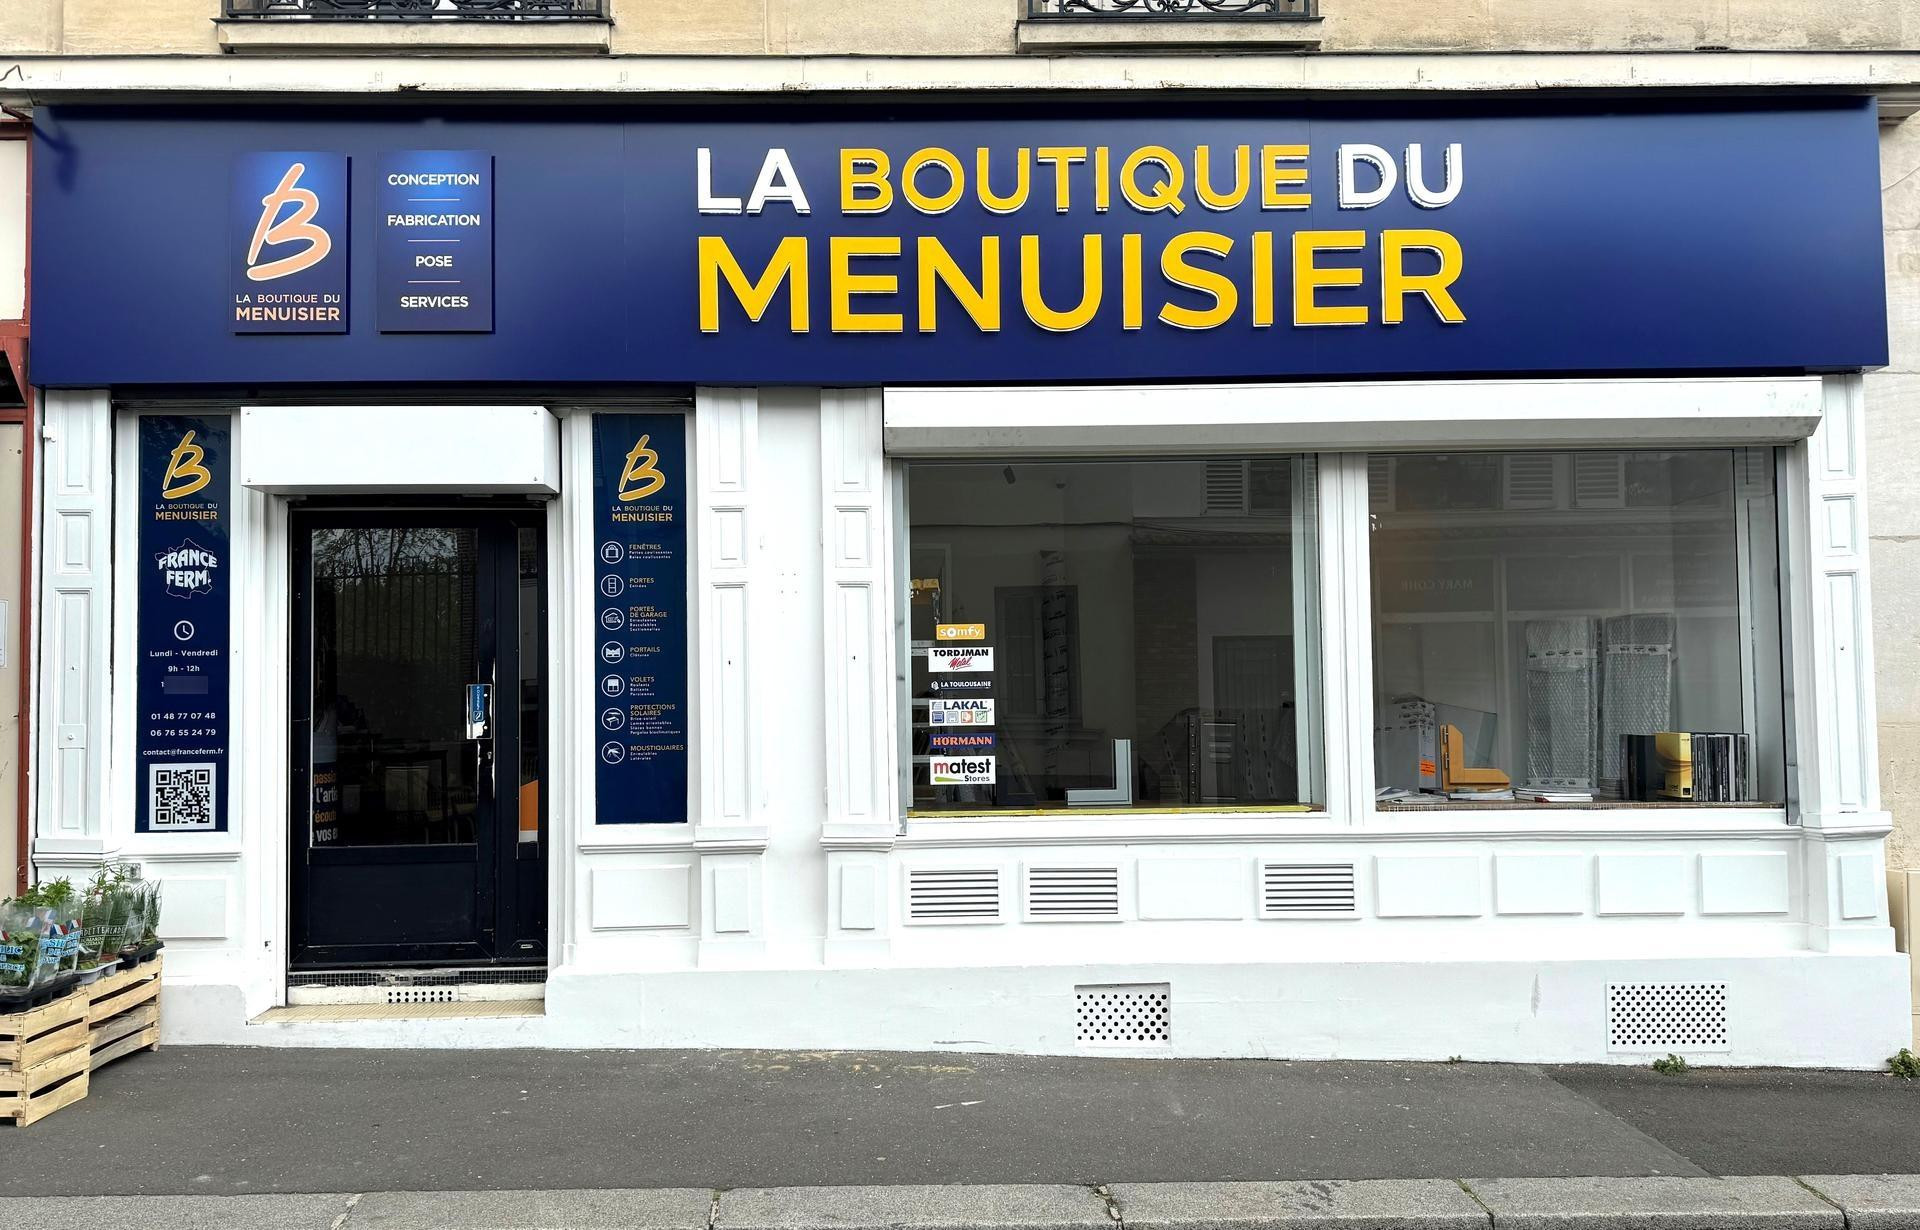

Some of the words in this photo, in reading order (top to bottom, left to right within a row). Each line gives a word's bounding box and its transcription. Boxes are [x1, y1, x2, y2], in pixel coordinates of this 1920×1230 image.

[387, 173, 480, 186] CONCEPTION
[697, 148, 811, 213] LA
[840, 144, 1311, 215] BOUTIQUE
[1338, 143, 1463, 209] DU
[387, 214, 481, 226] FABRICATION
[415, 255, 453, 267] POSE
[698, 229, 1467, 332] MENUISIER
[235, 294, 251, 303] LA
[257, 294, 318, 304] BOUTIQUE
[324, 294, 341, 303] DU
[400, 296, 469, 308] SERVICES
[235, 307, 340, 321] MENUISIER
[155, 511, 218, 521] MENUISIER
[612, 513, 673, 522] MENUISIER
[158, 549, 218, 570] FRANCE
[181, 649, 219, 657] Vendredi
[933, 649, 989, 657] TORDJMAN
[167, 665, 178, 673] 9h
[949, 680, 992, 688] TOULOUSAINE
[943, 700, 988, 710] LAKAL
[150, 729, 162, 737] 06
[205, 728, 217, 736] 79
[932, 736, 993, 746] HÖRMANN
[142, 747, 224, 757] contact@franceferm.fr
[630, 744, 684, 752] MOUSTIQUAIRES
[933, 758, 991, 774] matest
[314, 771, 336, 787] passio
[316, 785, 338, 803] l'arti
